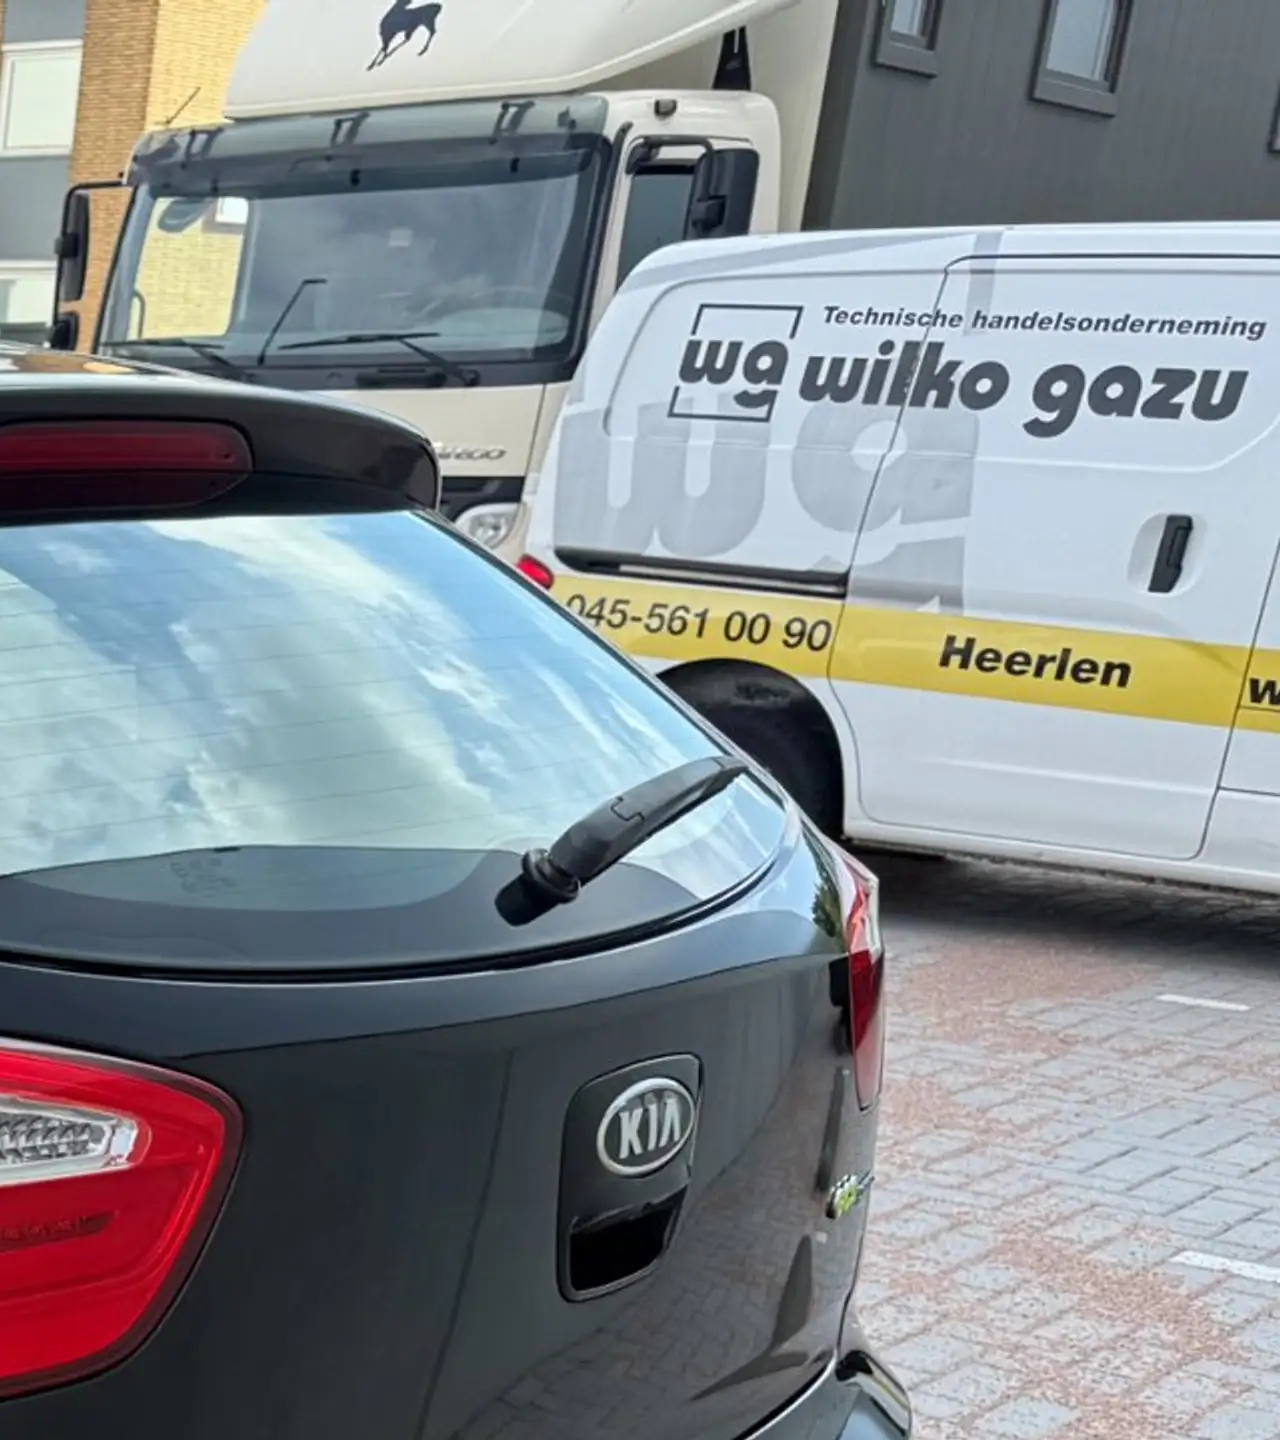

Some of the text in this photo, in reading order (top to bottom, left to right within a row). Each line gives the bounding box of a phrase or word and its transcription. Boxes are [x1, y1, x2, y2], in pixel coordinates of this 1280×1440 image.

[823, 305, 1268, 342] Technische handelsonderneming
[798, 339, 1250, 439] wilko gazu
[565, 594, 833, 652] 045-561 00 90
[938, 634, 1132, 689] Heerlen
[618, 1092, 682, 1160] KIA
